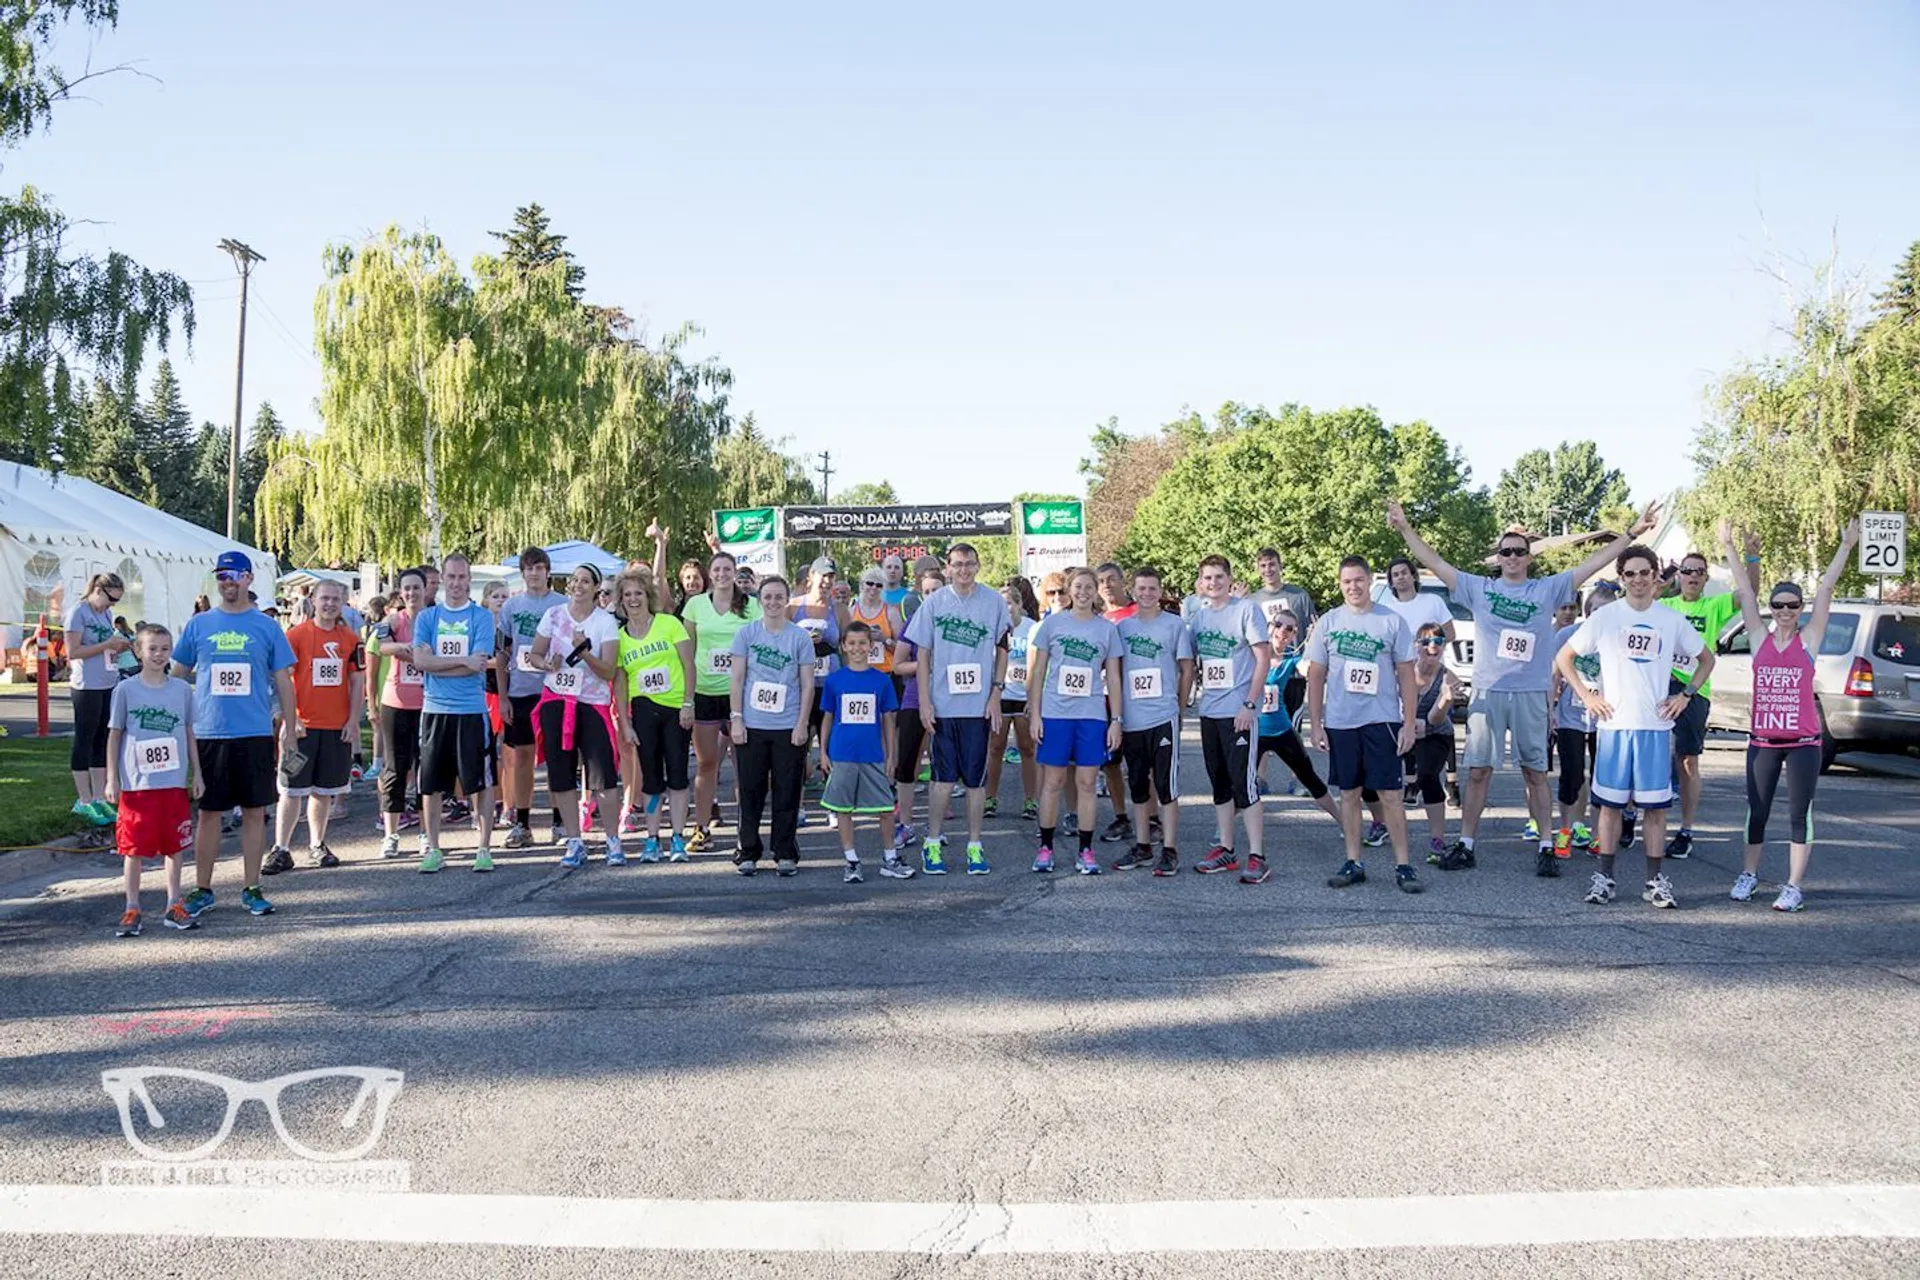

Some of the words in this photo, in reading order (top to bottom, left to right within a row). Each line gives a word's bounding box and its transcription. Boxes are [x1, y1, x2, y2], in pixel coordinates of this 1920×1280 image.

[822, 513, 863, 525] TETON
[867, 512, 897, 524] DAM
[901, 510, 976, 524] MARATHON
[1865, 518, 1902, 530] SPEED
[1868, 532, 1897, 542] LIMIT
[1865, 544, 1899, 567] 20
[442, 641, 461, 655] 830
[1506, 637, 1527, 653] 838
[1628, 634, 1651, 651] 837
[713, 652, 732, 667] 855
[220, 671, 242, 686] 882
[320, 665, 338, 678] 886
[954, 670, 975, 685] 815
[1207, 666, 1226, 681] 826
[1350, 669, 1372, 684] 875
[1757, 666, 1803, 676] CELEBRATE
[556, 673, 576, 687] 839
[644, 673, 664, 688] 840
[1065, 673, 1085, 688] 828
[1134, 675, 1154, 690] 827
[1757, 674, 1802, 688] EVERY
[757, 689, 778, 704] 804
[1756, 694, 1800, 703] CROSSING
[848, 701, 869, 715] 876
[1756, 703, 1769, 712] THE
[1770, 703, 1799, 712] FINISH
[1754, 712, 1799, 730] LINE
[146, 746, 170, 763] 883
